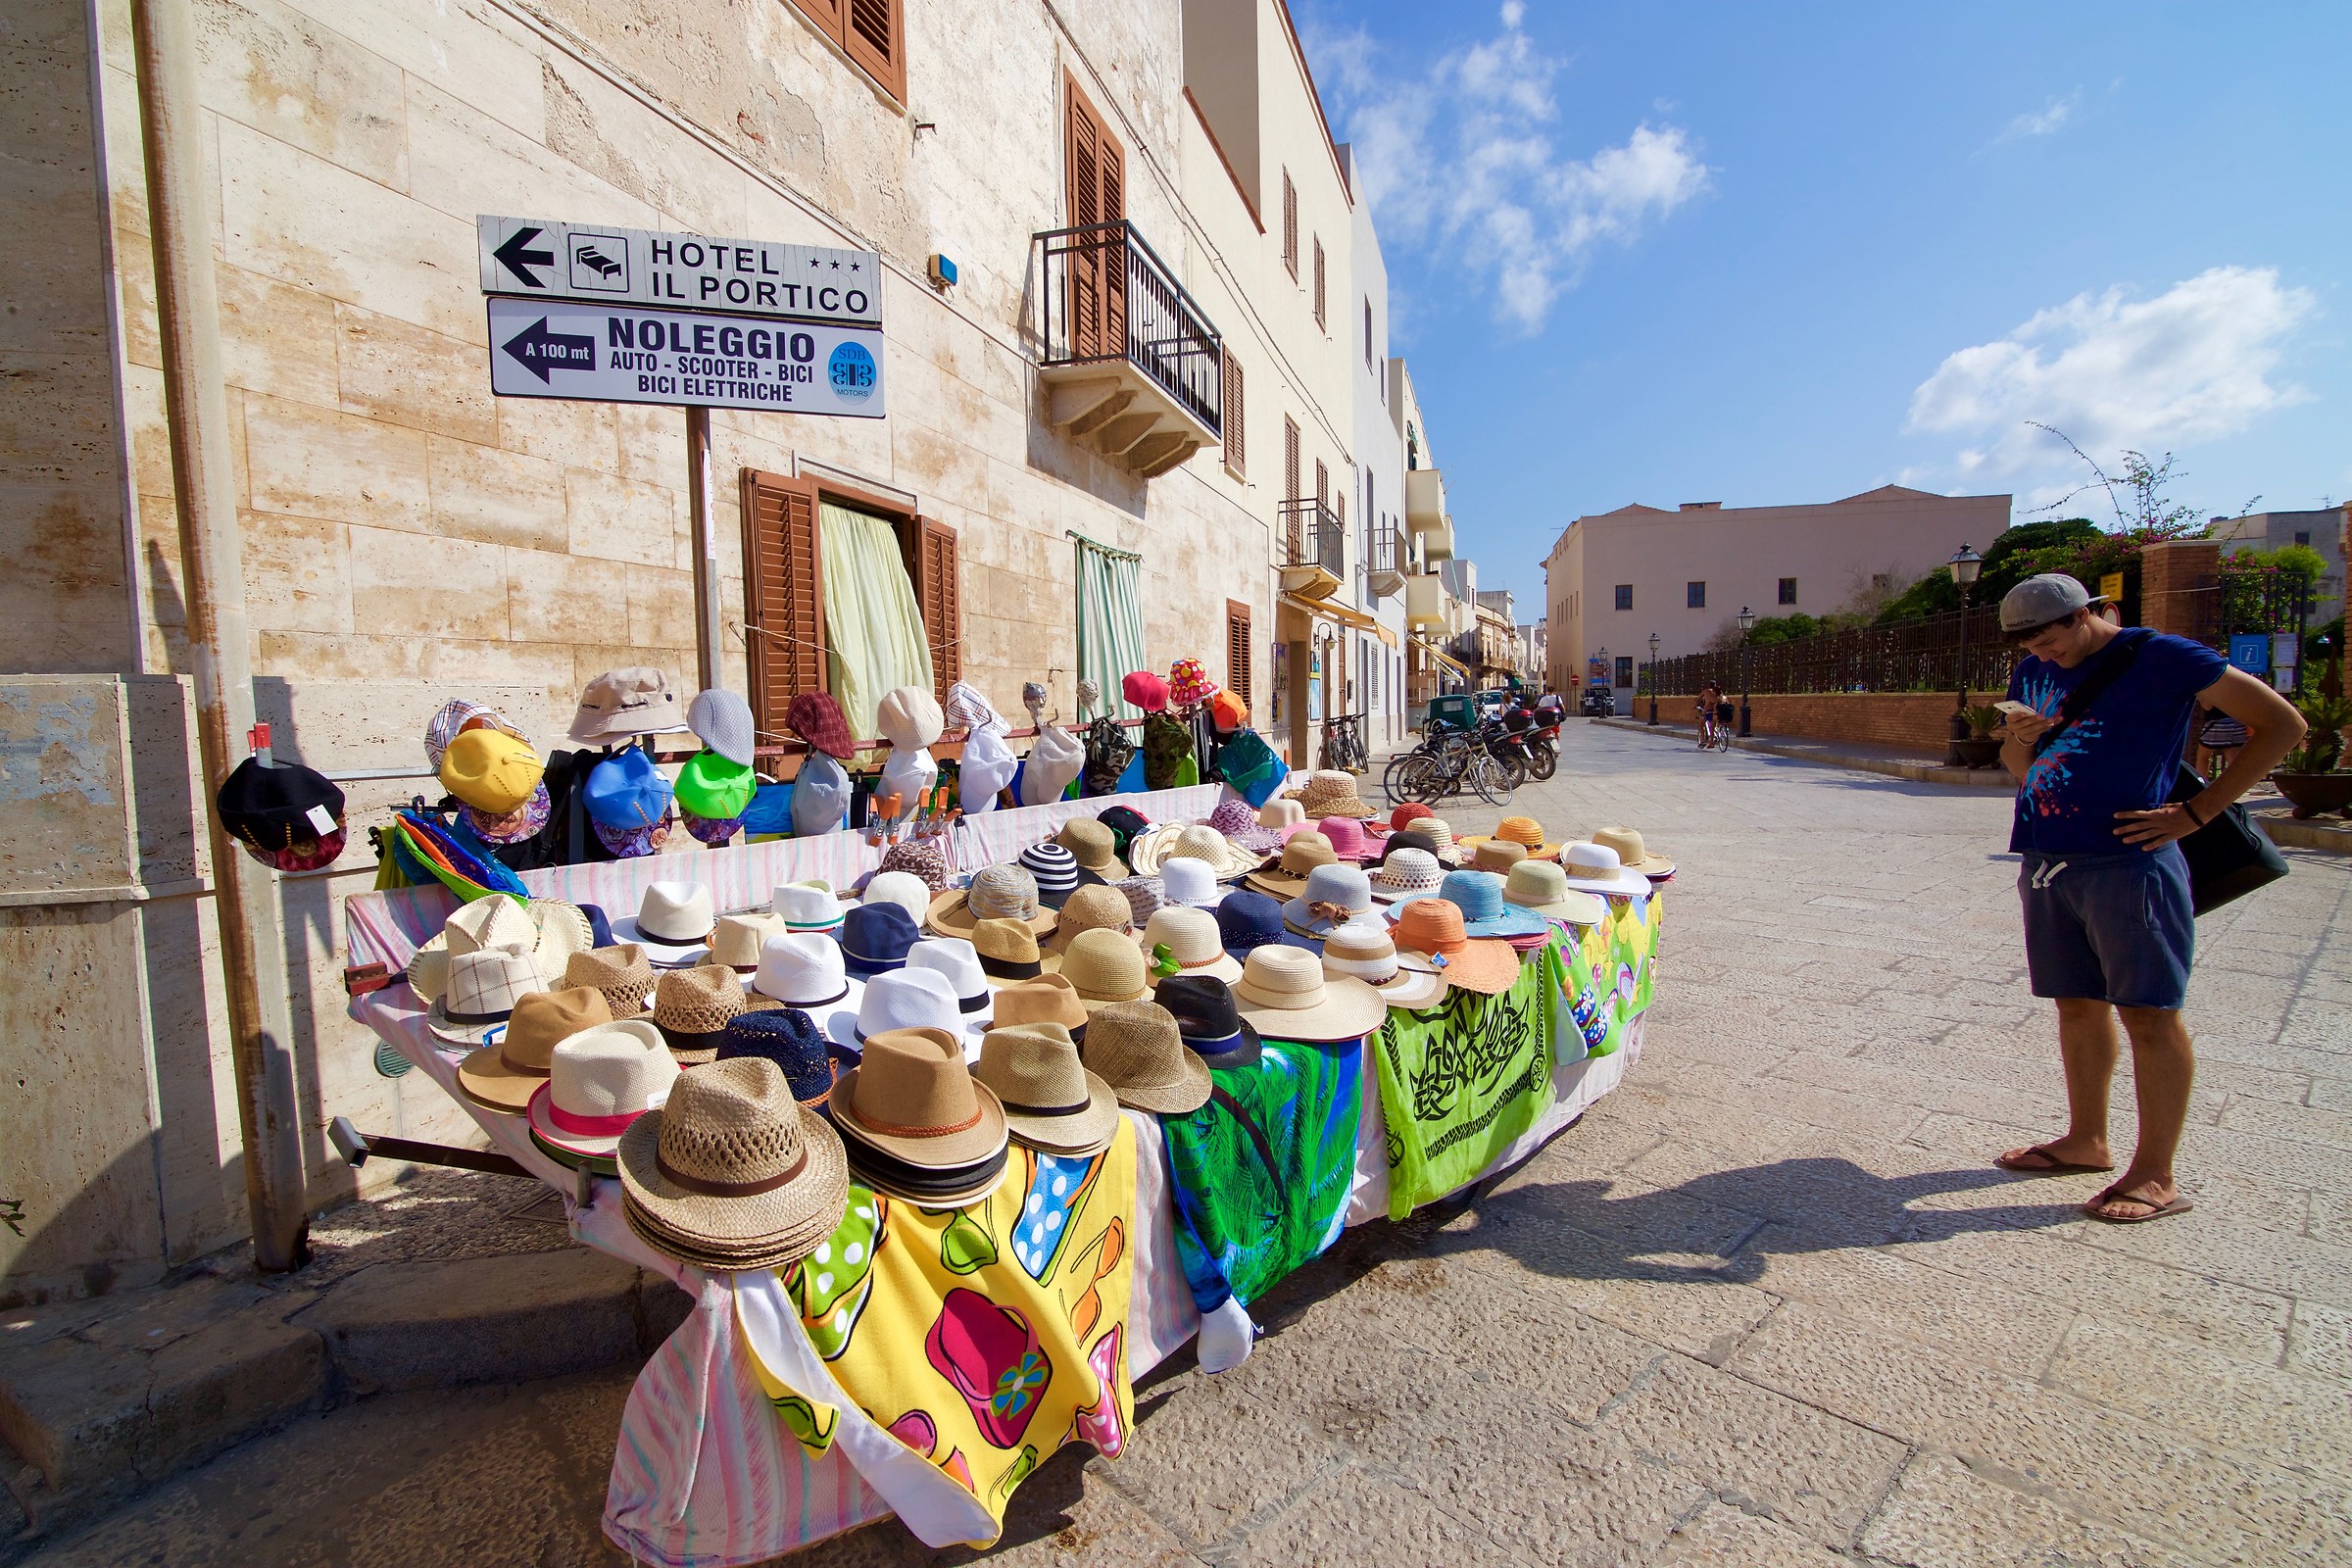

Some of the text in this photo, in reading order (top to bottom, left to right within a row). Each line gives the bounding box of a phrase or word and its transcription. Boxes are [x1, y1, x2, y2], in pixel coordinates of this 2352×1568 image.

[651, 239, 779, 275] HOTEL
[652, 271, 869, 315] IL PORTICO
[525, 343, 590, 361] A 100 mt
[608, 317, 815, 364] NOLEGGIO
[838, 347, 866, 361] SDB
[610, 351, 658, 372] AUTO
[677, 357, 759, 380] SCOOTER
[777, 363, 813, 383] BICI
[638, 375, 793, 403] BICI ELETTRICHE
